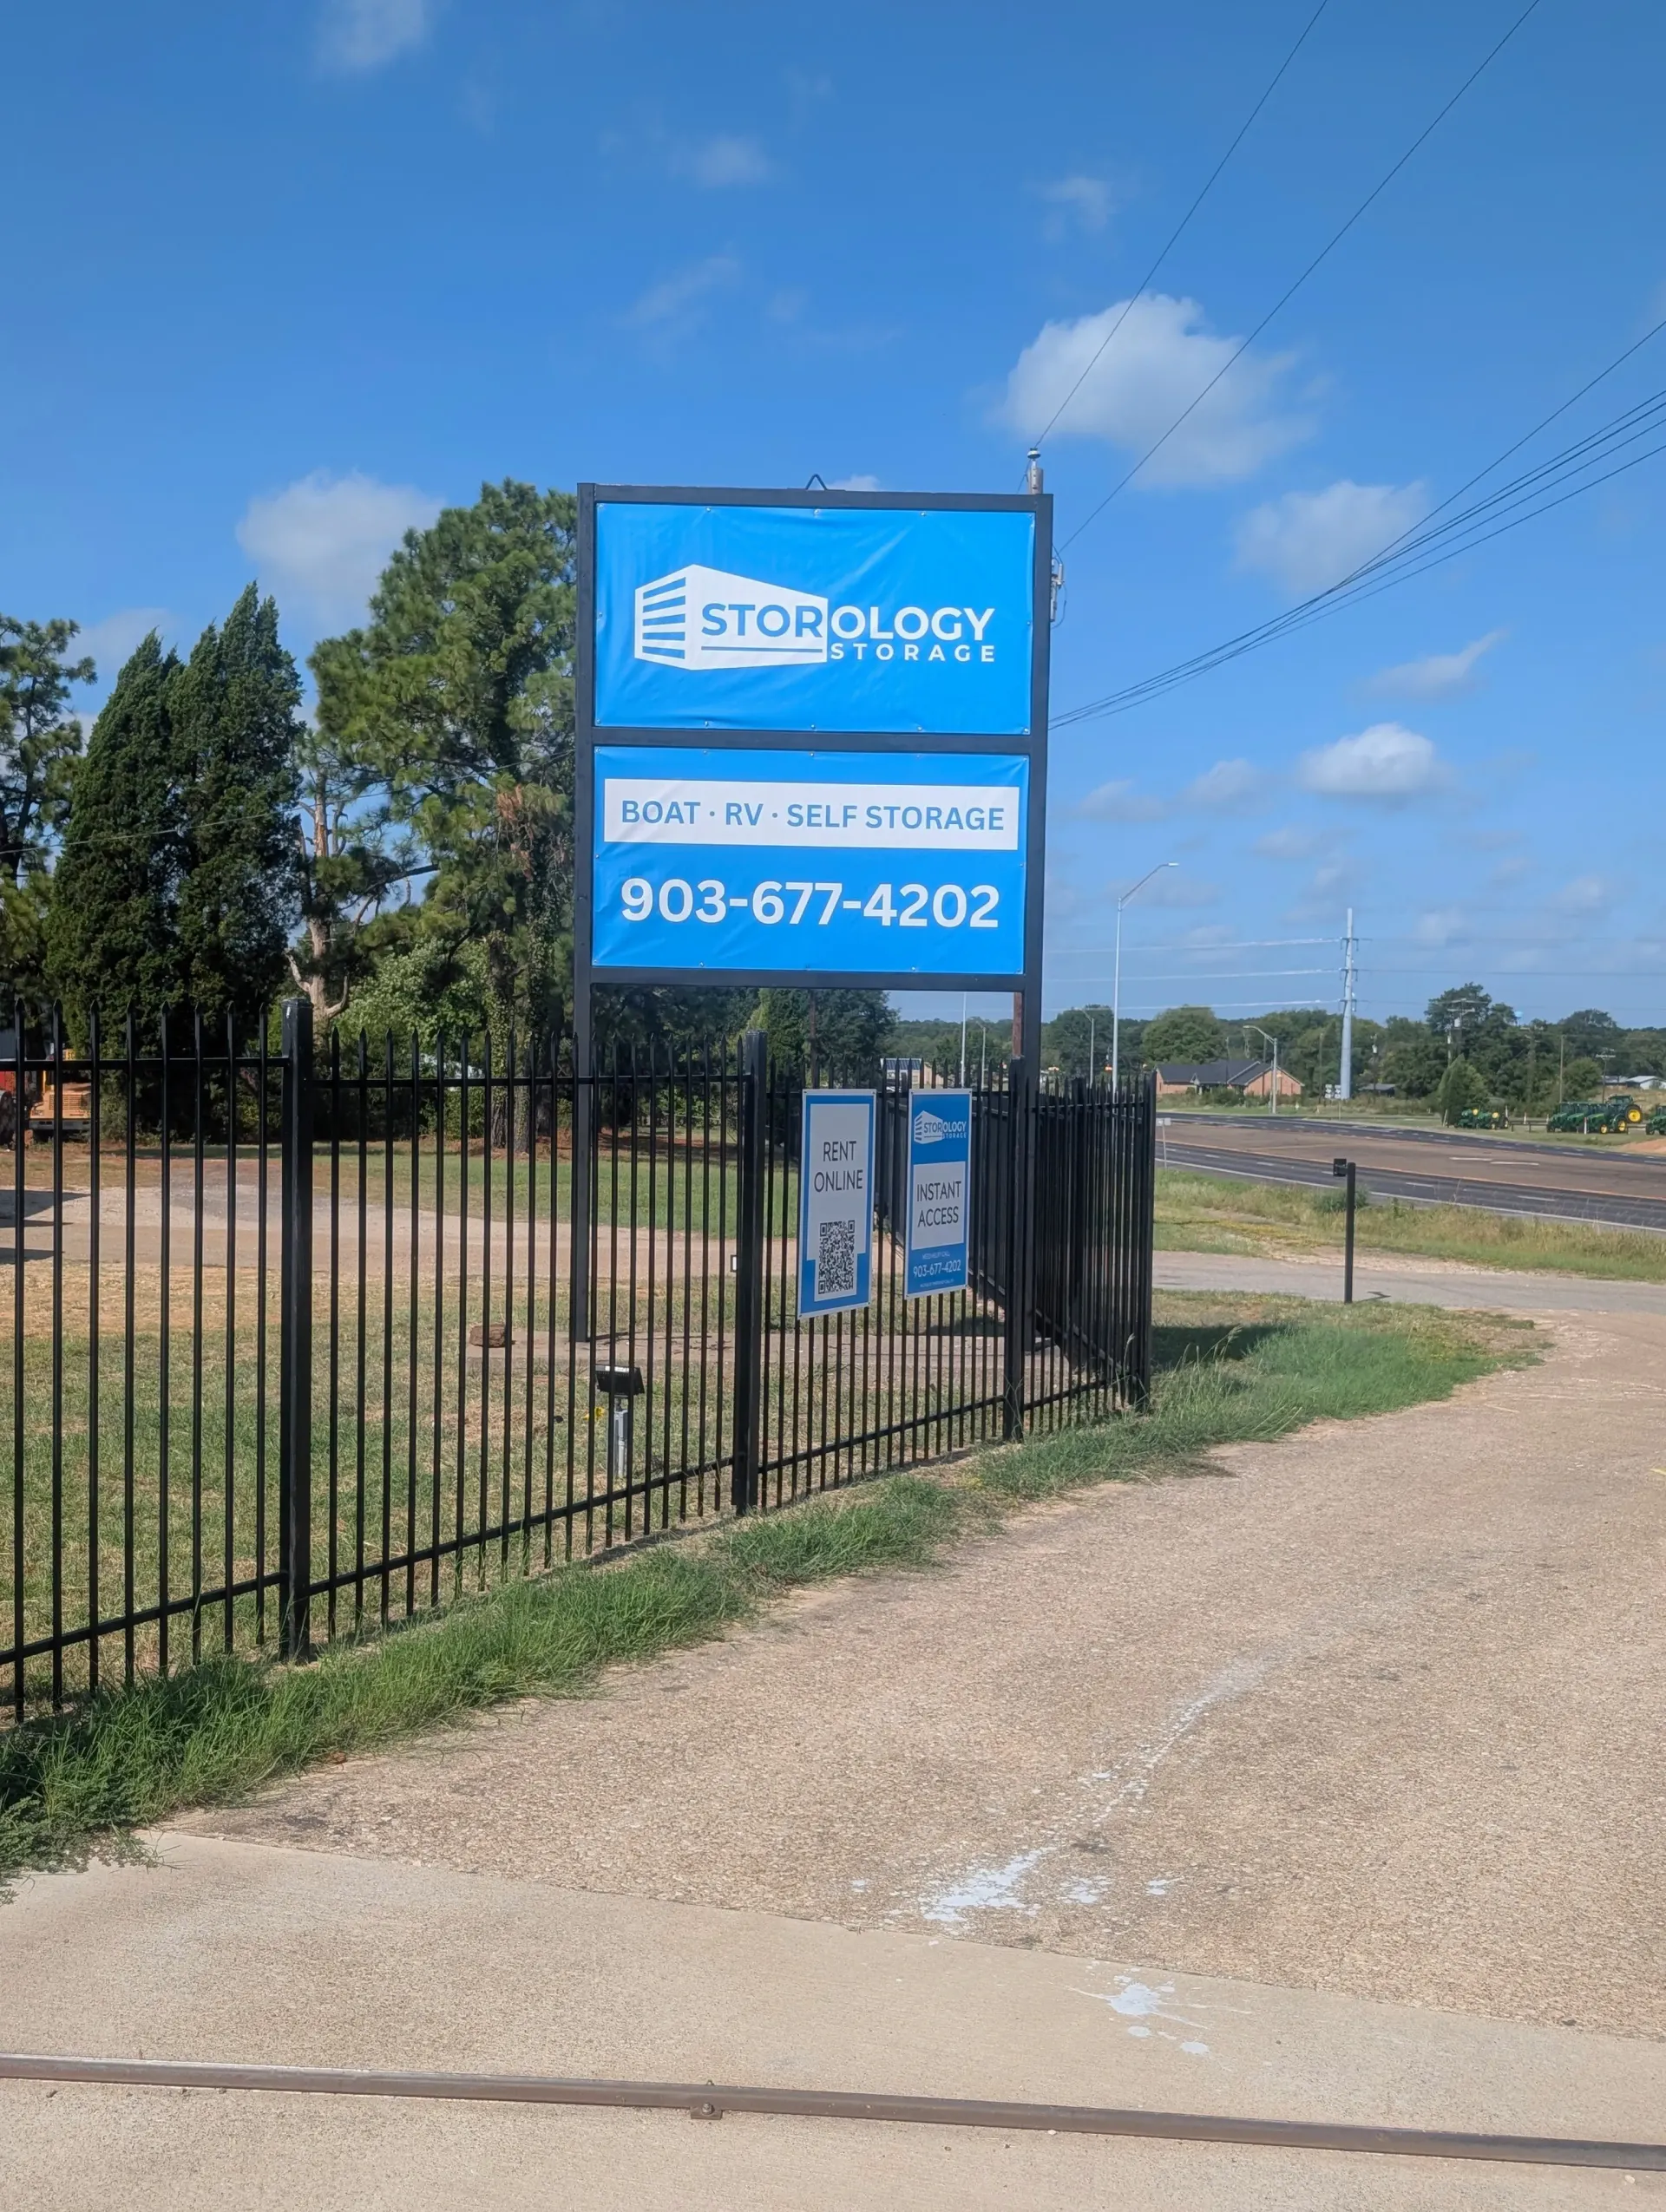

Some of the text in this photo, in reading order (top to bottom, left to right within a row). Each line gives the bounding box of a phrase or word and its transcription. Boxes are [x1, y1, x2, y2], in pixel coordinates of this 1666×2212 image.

[701, 602, 995, 641] STOROLOGY
[830, 642, 994, 663] STORAGE
[621, 800, 1005, 832] BOAT RV SELF STORAGE
[620, 877, 1000, 929] 903-677-4202
[923, 1121, 967, 1134] STOROLOGY
[823, 1140, 857, 1162] RENT
[814, 1168, 863, 1193] ONLINE
[916, 1181, 962, 1202] INSTANT
[917, 1205, 959, 1228] ACCESS
[913, 1259, 961, 1278] 903-677-4202
